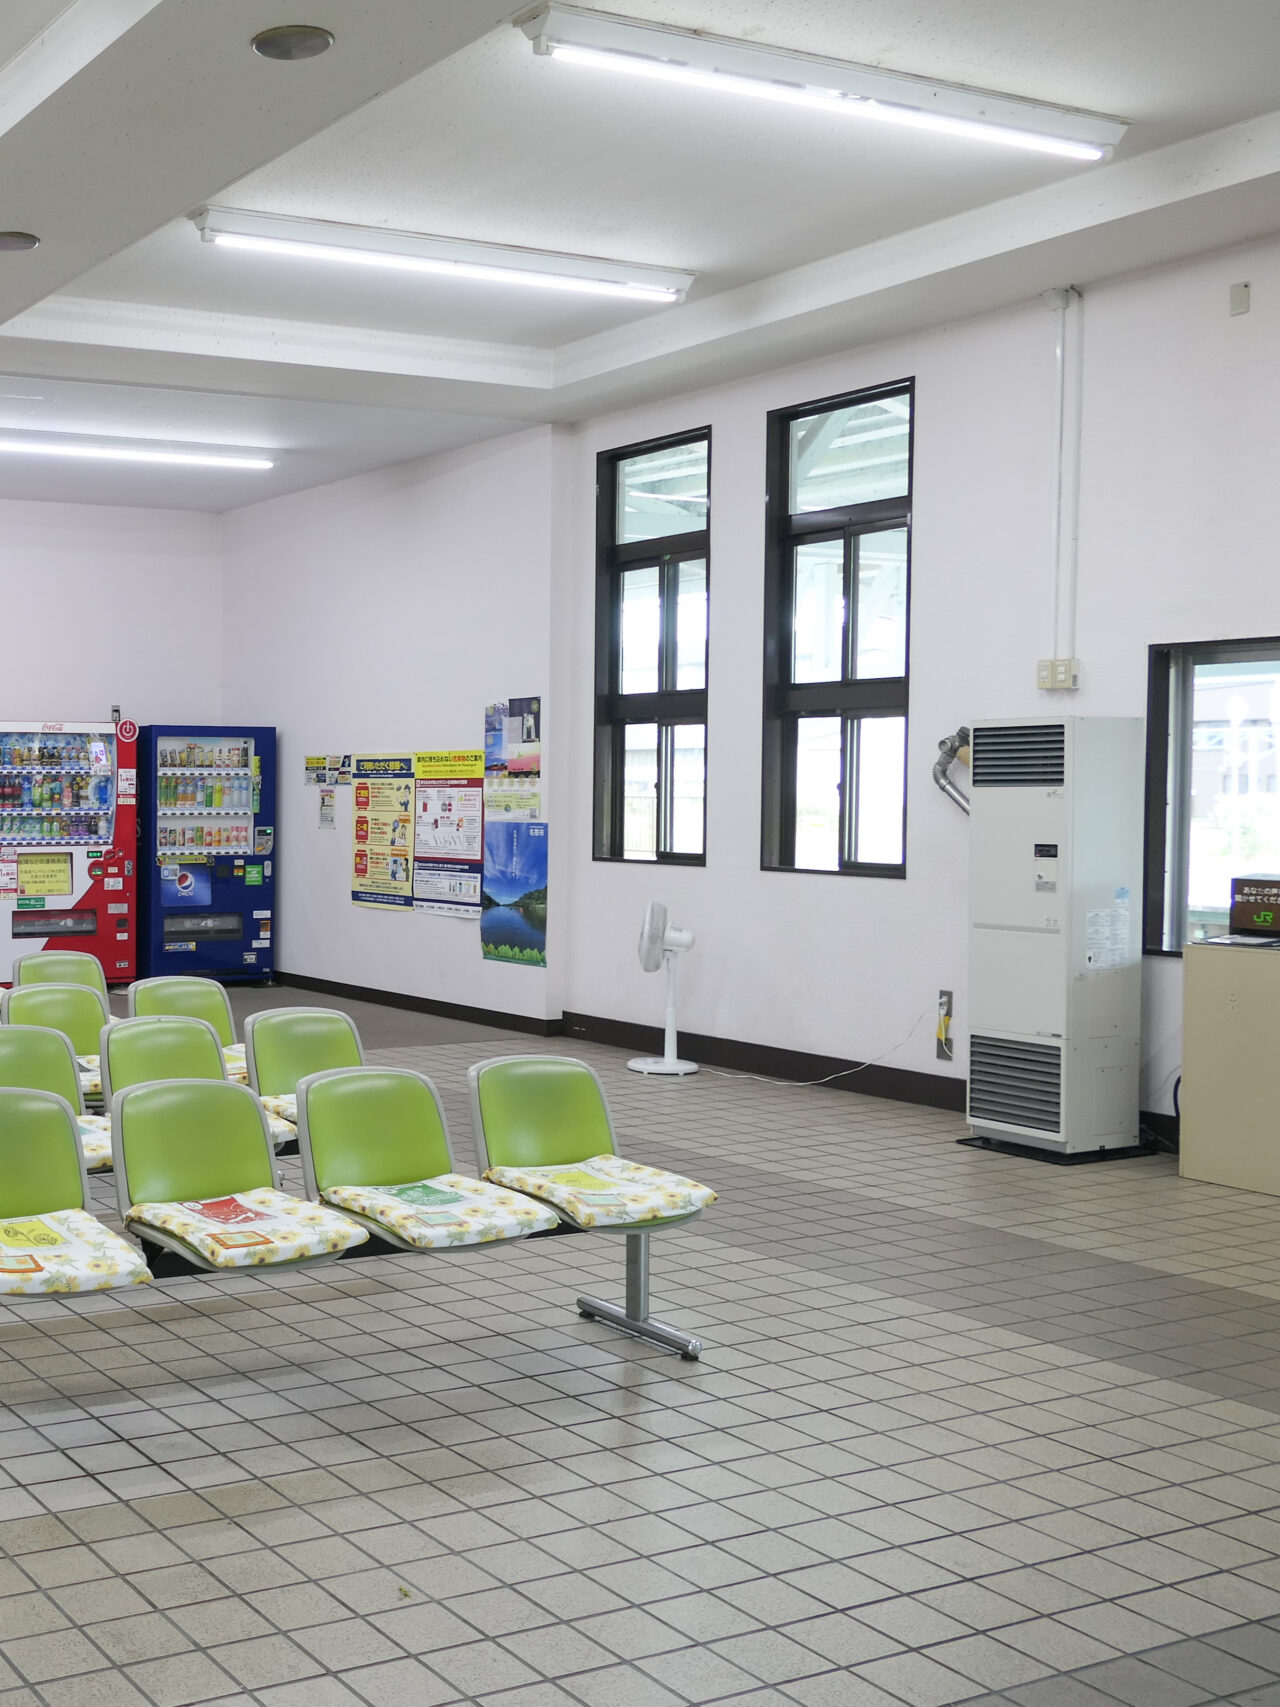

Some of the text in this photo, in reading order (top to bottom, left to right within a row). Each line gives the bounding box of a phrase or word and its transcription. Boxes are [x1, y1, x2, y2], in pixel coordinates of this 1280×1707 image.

[1243, 886, 1280, 895] あなたの声
[1253, 911, 1273, 923] JR
